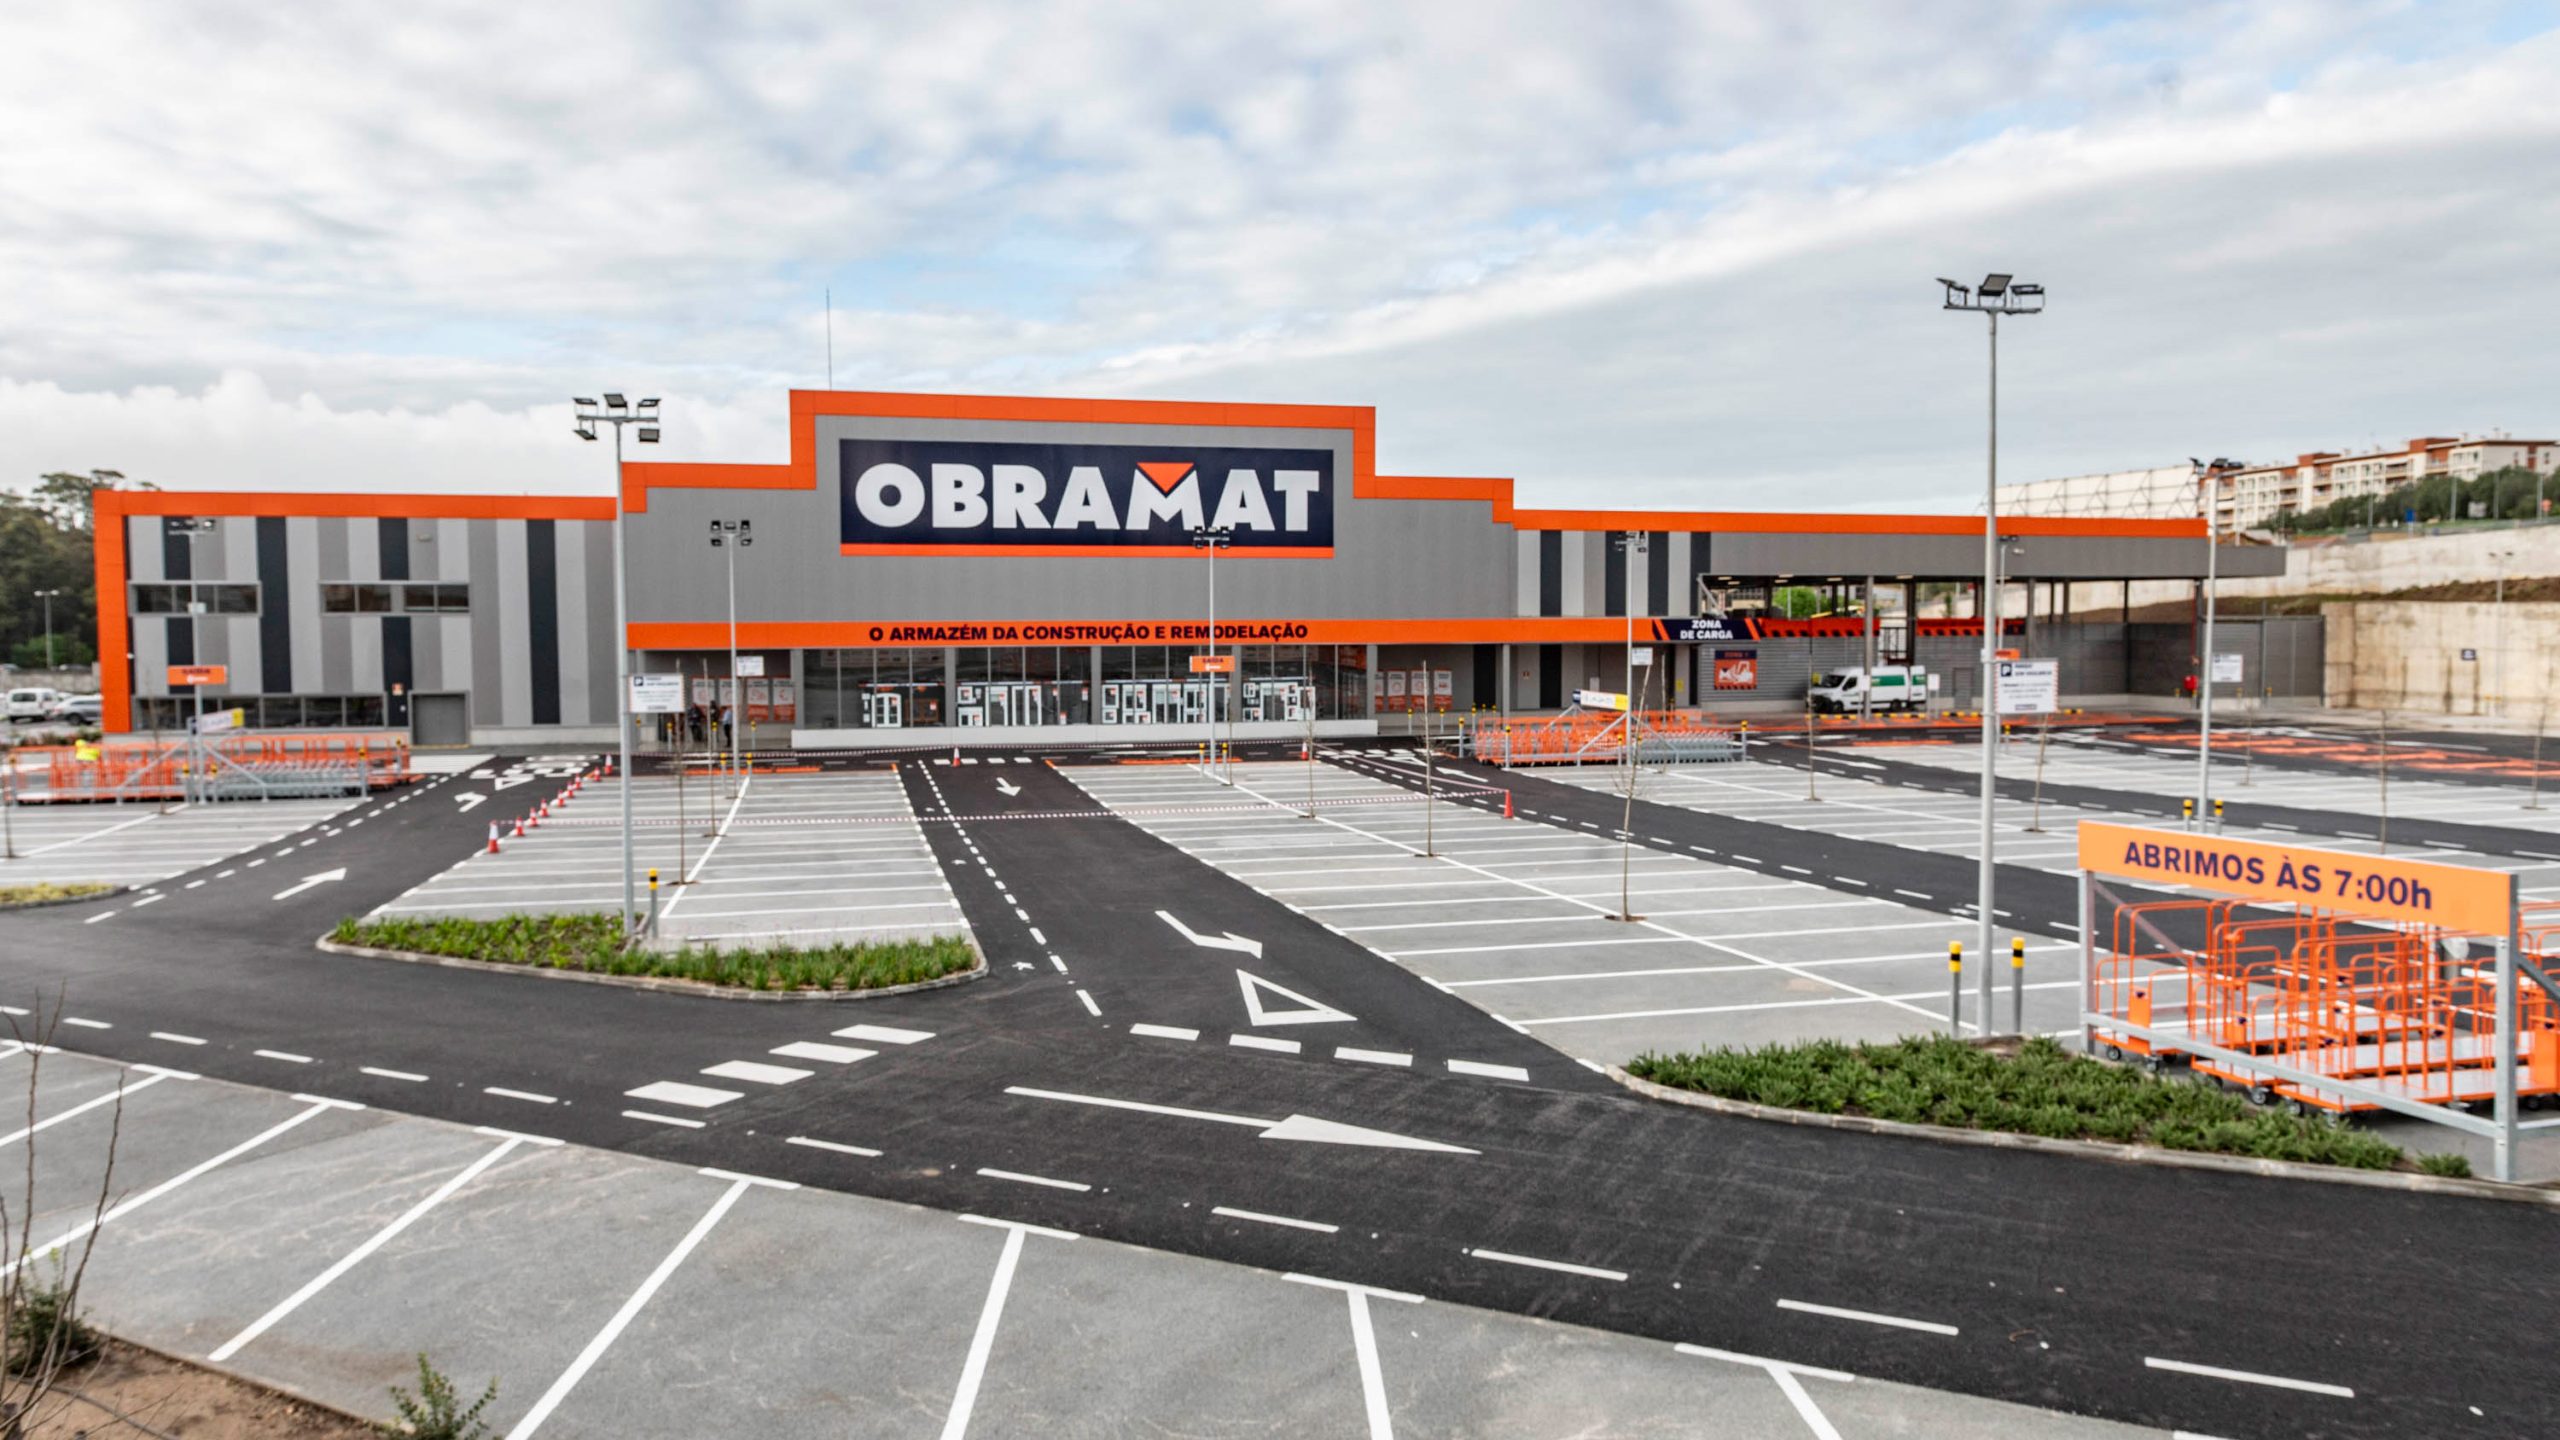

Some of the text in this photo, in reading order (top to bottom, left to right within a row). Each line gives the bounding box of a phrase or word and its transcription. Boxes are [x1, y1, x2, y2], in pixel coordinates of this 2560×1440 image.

[854, 461, 1320, 532] OBRAMAT
[869, 622, 1308, 643] O ARMAZÉM DA CONSTRUÇÃO E REMODELAÇÃO
[1692, 619, 1722, 628] ZONA
[1680, 630, 1733, 639] DE CARGA
[2124, 841, 2432, 911] ABRIMOS ÀS 7:00h
